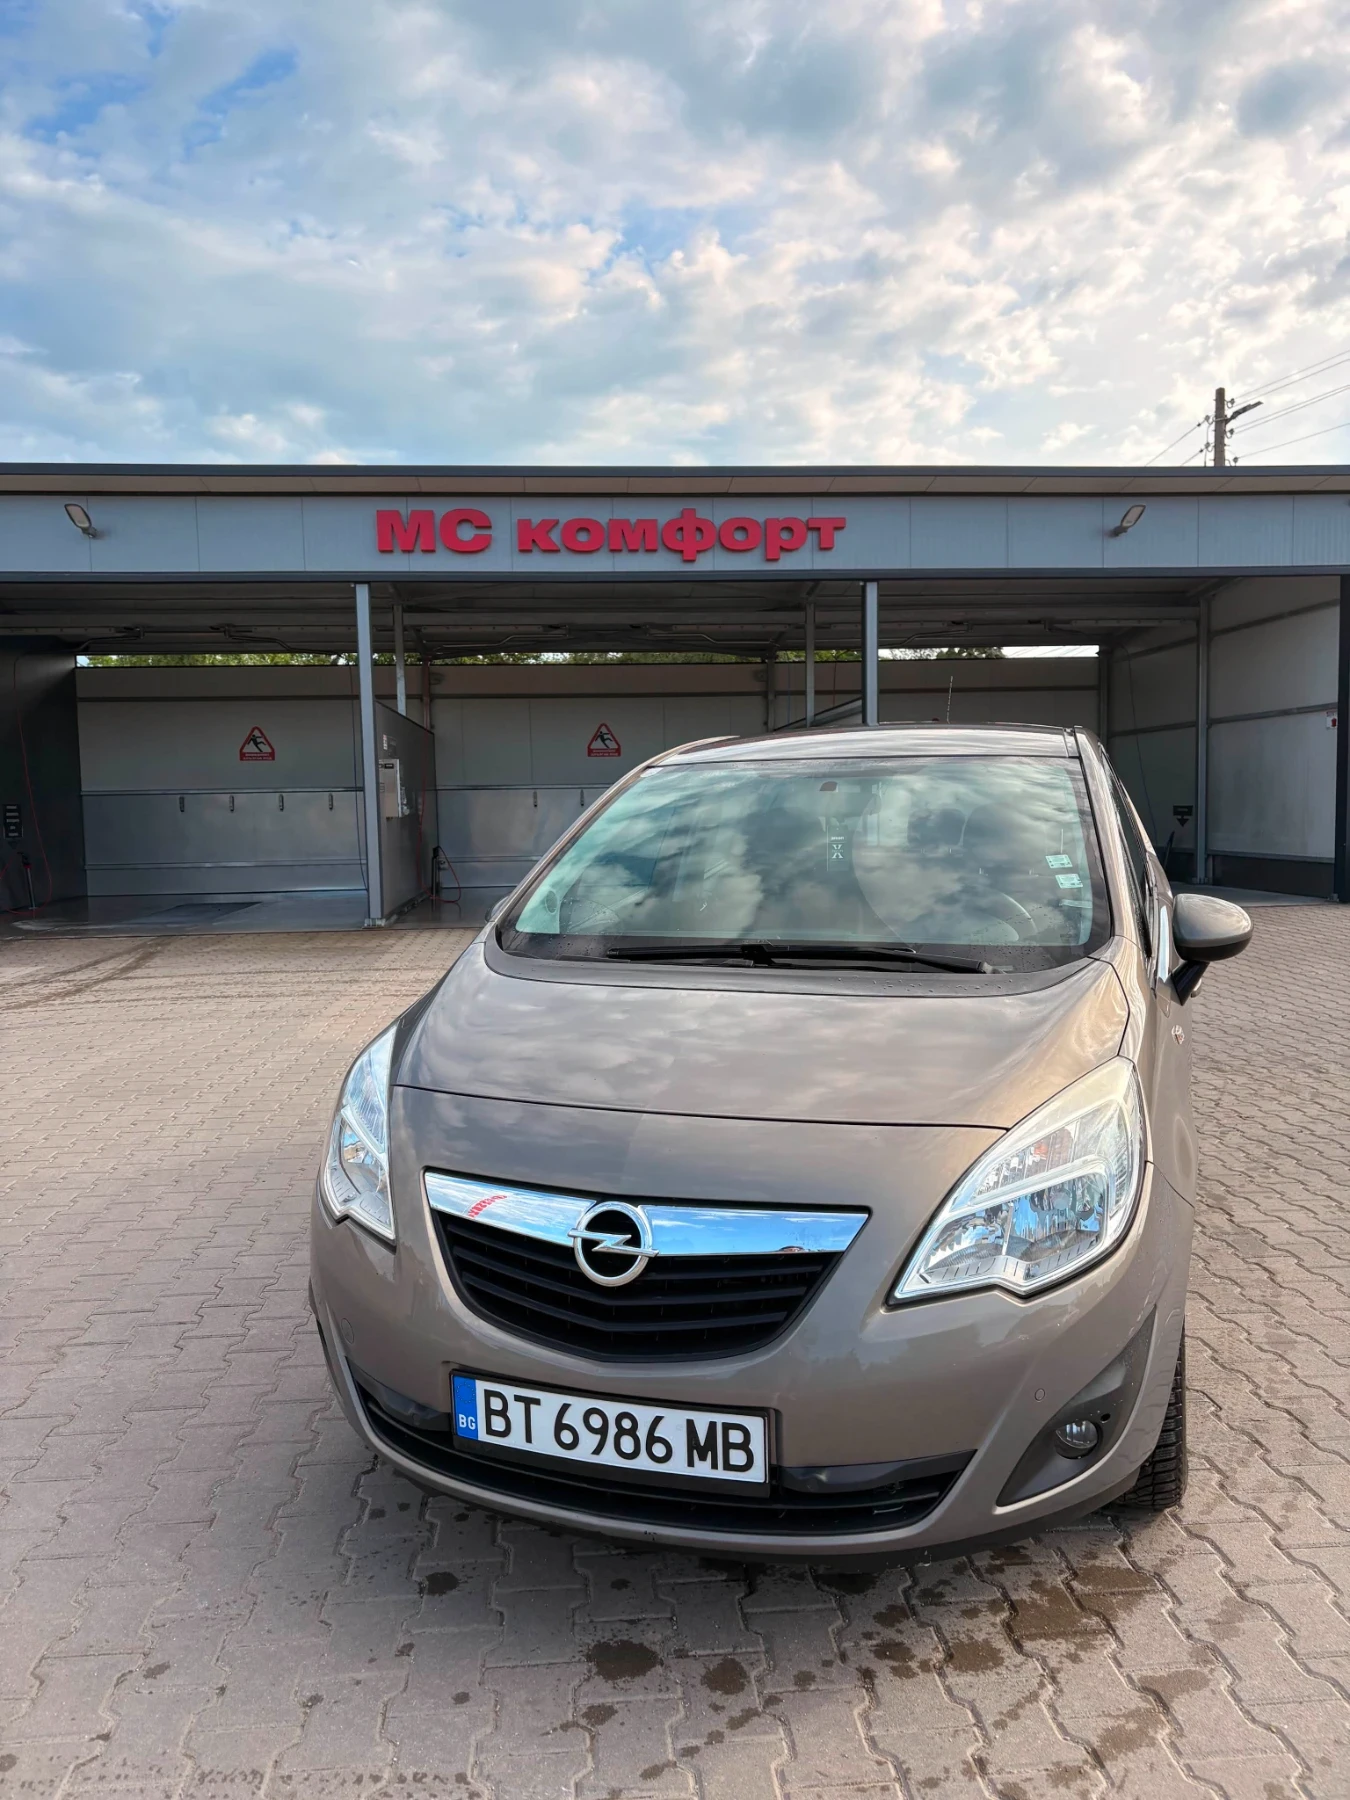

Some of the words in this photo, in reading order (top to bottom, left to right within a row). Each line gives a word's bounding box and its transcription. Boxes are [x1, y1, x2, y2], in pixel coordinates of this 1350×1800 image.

[376, 508, 492, 553] МС
[517, 508, 847, 562] комфорт
[458, 1413, 476, 1431] BG
[553, 1402, 673, 1464] 6986
